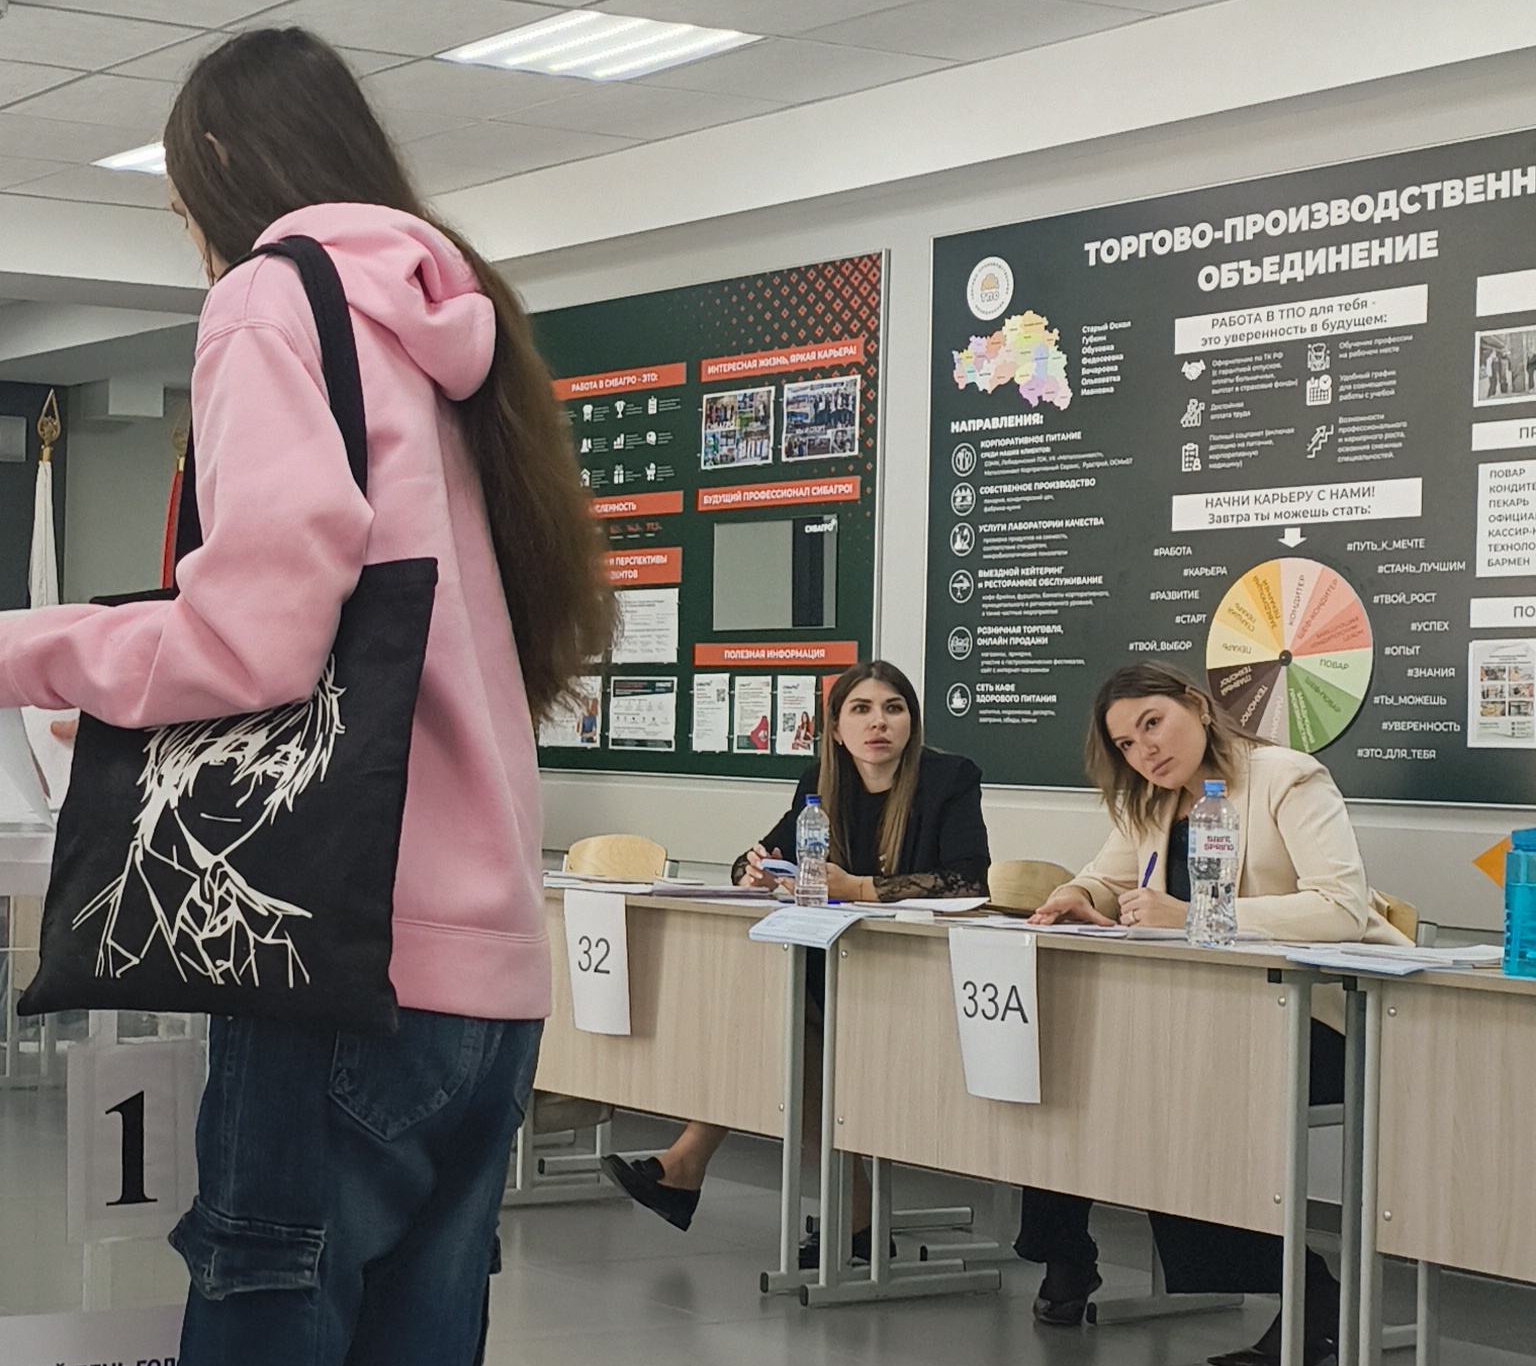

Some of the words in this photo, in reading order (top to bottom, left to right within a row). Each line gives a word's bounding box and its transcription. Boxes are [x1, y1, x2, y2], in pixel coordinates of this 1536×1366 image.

[1084, 165, 1536, 267] ТОРГОВО-ПРОИЗВОДСТВЕНН
[1197, 229, 1439, 293] ОБЪЕДИНЕНИЕ
[1211, 311, 1262, 329] РАБОТА
[1266, 310, 1275, 322] В
[1278, 304, 1307, 319] ТПО
[1308, 304, 1334, 318] для
[1336, 297, 1368, 312] тебя
[1201, 335, 1221, 348] это
[1224, 323, 1307, 347] уверенность
[1310, 322, 1318, 332] в
[1321, 313, 1388, 333] будущем:
[707, 359, 758, 375] ИНТЕРЕСНАЯ
[789, 351, 816, 363] ЯРКАЯ
[817, 345, 858, 359] КАРЬЕРА!
[571, 378, 598, 392] РАБОТА
[598, 380, 603, 389] В
[604, 375, 637, 388] СИБАГРО
[642, 373, 658, 383] ЭТО:
[950, 412, 1044, 433] НАПРАВЛЕНИЯ:
[980, 434, 1045, 448] КОРПОРАТИВНОЕ
[1045, 431, 1082, 442] ПИТАНИЕ
[1489, 468, 1526, 479] ПОВАР
[979, 484, 1033, 495] СОБСТВЕННОЕ
[1034, 478, 1096, 491] ПРОИЗВОДСТВО
[703, 491, 742, 505] БУДУЩИЙ
[742, 487, 811, 501] ПРОФЕССИОНАЛ
[811, 483, 853, 496] СИБАГРО!
[1205, 495, 1251, 509] НАЧНИ
[1254, 491, 1314, 506] КАРЬЕРУ
[1317, 489, 1326, 501] С
[1329, 486, 1376, 501] НАМИ!
[1488, 498, 1530, 509] ПЕКАРЬ
[1208, 510, 1252, 525] Завтра
[1254, 512, 1271, 523] ты
[1273, 507, 1329, 520] можешь
[1332, 504, 1371, 517] стать:
[1488, 513, 1536, 524] ОФИЦИА
[978, 523, 1007, 533] УСЛУГИ
[1007, 519, 1064, 532] ЛАБОРАТОРИИ
[1065, 517, 1105, 527] КАЧЕСТВА
[1153, 546, 1193, 557] #РАБОТА
[1346, 538, 1426, 552] #ПУТЬ_К_МЕЧТЕ
[1488, 542, 1536, 553] ТЕХНОЛО
[615, 555, 668, 566] ПЕРСПЕКТИВЫ
[1487, 558, 1530, 568] БАРМЕН
[978, 568, 1020, 579] ВЫЕЗДНОЙ
[1020, 566, 1064, 576] КЕЙТЕРИНГ
[1183, 566, 1228, 577] #КАРЬЕРА
[1377, 561, 1466, 575] #СТАНЬ_ЛУЧШИМ
[984, 578, 1037, 589] РЕСТОРАННОЕ
[1038, 575, 1103, 587] ОБСЛУЖИВАНИЕ
[1150, 590, 1200, 601] #РАЗВИТИЕ
[1289, 574, 1305, 626] КОНДИТЕР
[1372, 592, 1437, 605] #ТВОЙ_РОСТ
[1175, 614, 1207, 624] #СТАРТ
[977, 625, 1021, 635] РОЗНИЧНАЯ
[1022, 625, 1064, 635] ТОРГОВЛЯ,
[1410, 621, 1450, 632] #УСПЕХ
[976, 636, 1008, 646] ОНЛАЙН
[1009, 636, 1048, 647] ПРОДАЖИ
[1128, 641, 1193, 652] #ТВОЙ_ВЫБОР
[723, 649, 765, 660] ПОЛЕЗНАЯ
[766, 648, 826, 660] ИНФОРМАЦИЯ
[1222, 643, 1252, 654] ПЕКАРЬ
[1384, 646, 1421, 657] #ОПЫТ
[1319, 659, 1350, 670] ПОВАР
[1406, 667, 1456, 679] #ЗНАНИЯ
[976, 683, 994, 692] СЕТЬ
[995, 683, 1015, 692] КАФЕ
[976, 694, 1020, 703] ЗДОРОВОГО
[1020, 694, 1057, 703] ПИТАНИЯ
[1373, 695, 1447, 707] #ТЫ_МОЖЕШЬ
[1240, 685, 1268, 728] ТЕХНОЛОГ
[1381, 721, 1461, 734] #УВЕРЕННОСТЬ
[1357, 748, 1437, 760] #ЭТО_ДЛЯ_ТЕБЯ
[578, 935, 611, 974] 32
[962, 980, 1029, 1024] 33А
[105, 1090, 158, 1207] 1
